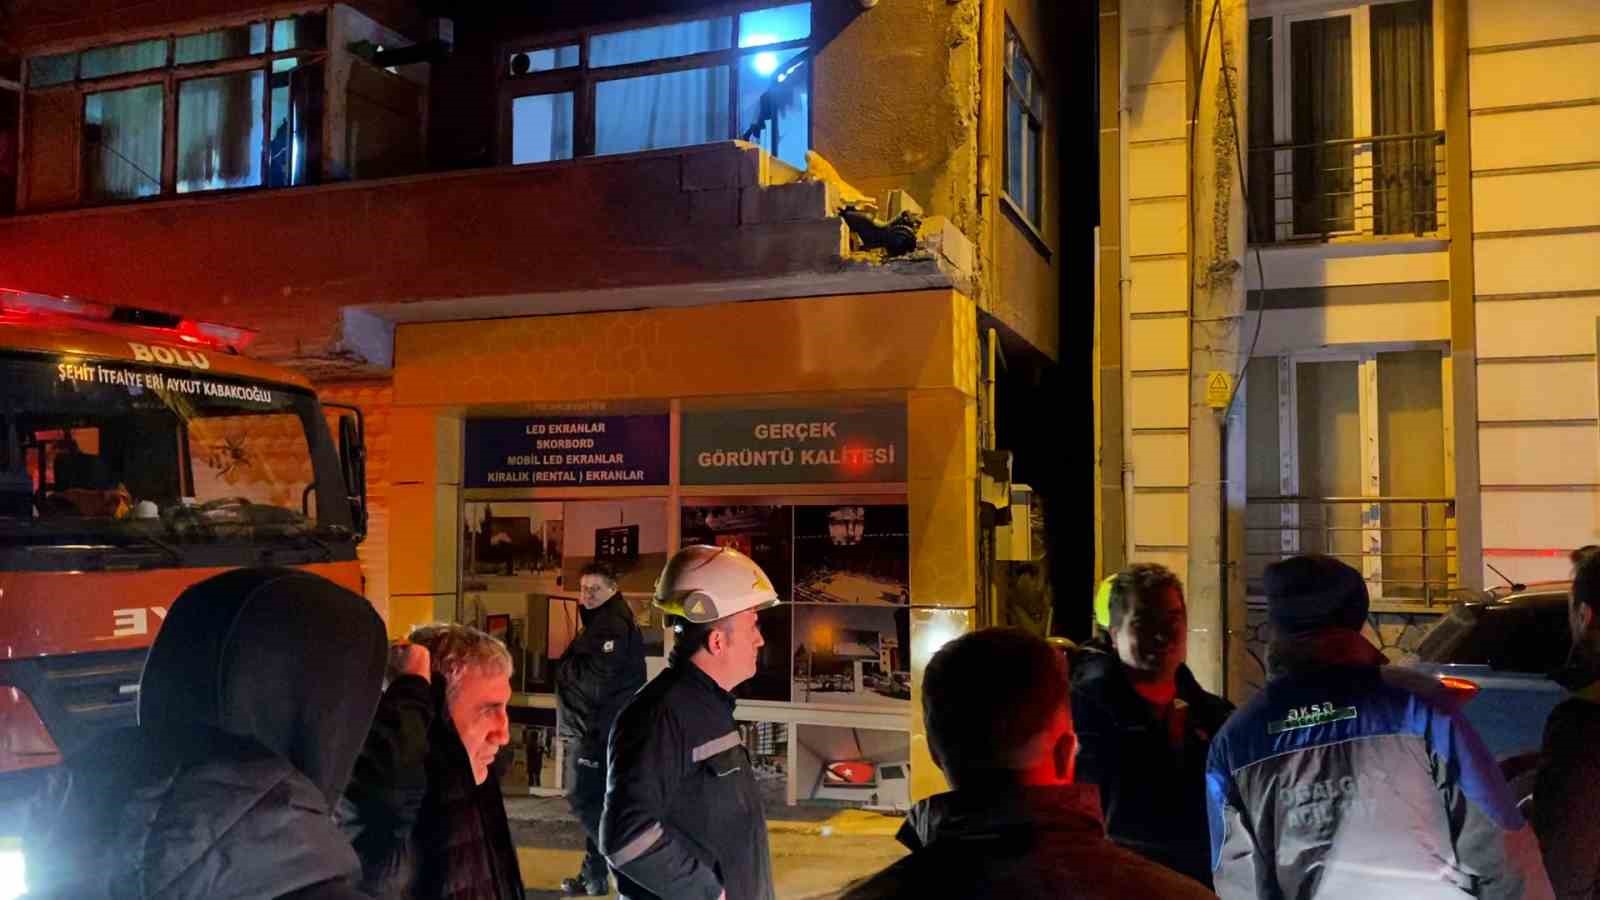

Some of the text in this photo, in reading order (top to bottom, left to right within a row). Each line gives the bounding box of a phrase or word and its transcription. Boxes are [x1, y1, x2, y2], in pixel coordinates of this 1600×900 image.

[128, 342, 210, 369] BOLU
[58, 363, 272, 403] ŞEHİT İTFAİYE ERİ AYKUT KABAKCIOĞLU
[526, 422, 606, 435] LED EKRANLAR
[754, 422, 837, 442] GERÇEK
[536, 438, 594, 449] SKORBORD
[507, 453, 624, 466] MOBİL LED EKRANLAR
[698, 444, 895, 467] GÖRÜNTÜ KALİTESİ
[586, 470, 644, 481] EKRANLAR
